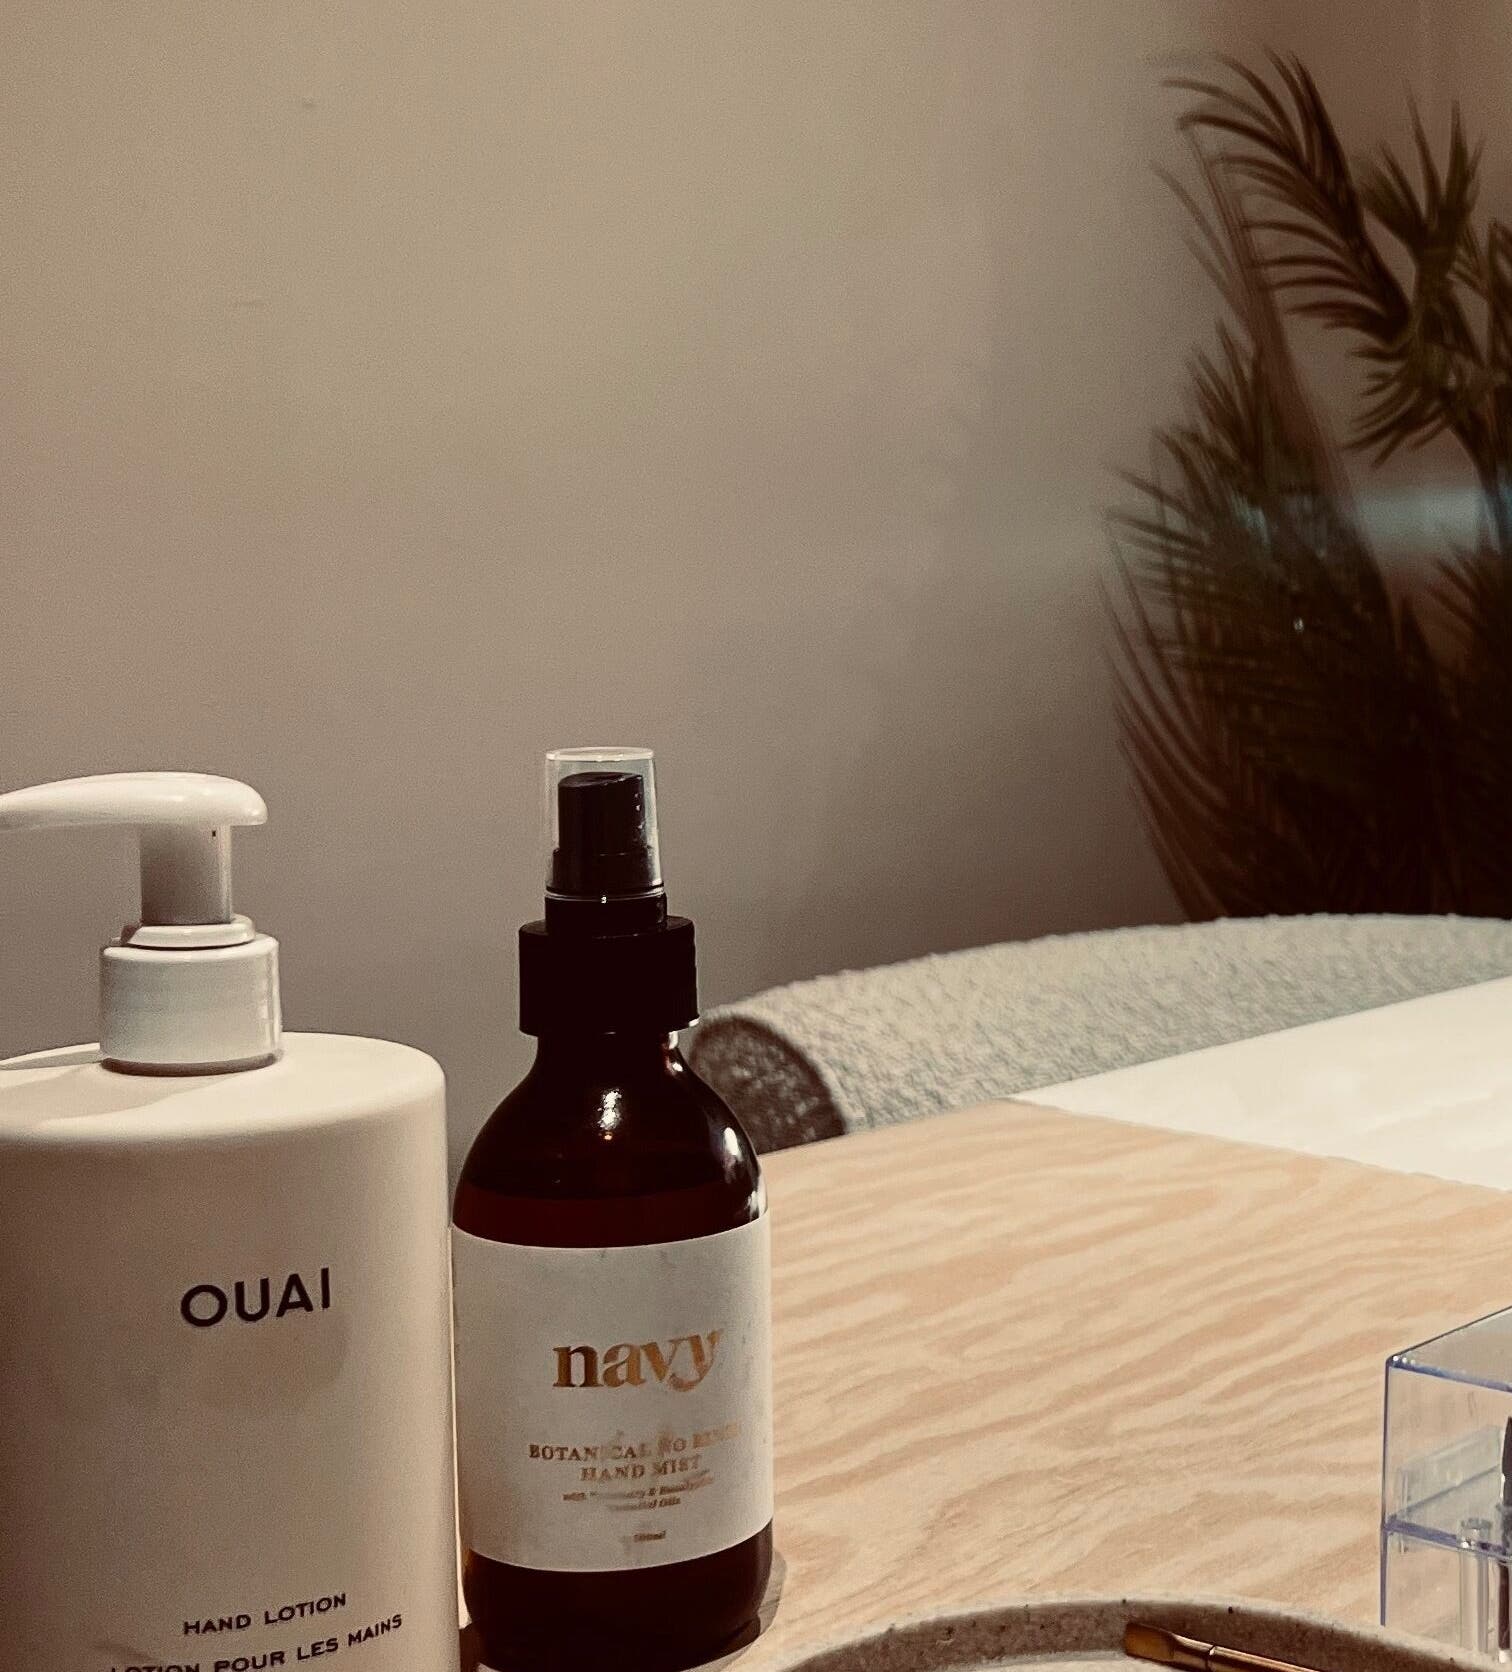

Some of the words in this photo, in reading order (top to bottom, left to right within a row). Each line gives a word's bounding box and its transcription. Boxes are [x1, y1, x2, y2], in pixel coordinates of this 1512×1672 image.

[180, 1267, 331, 1327] OUAI
[552, 1328, 723, 1392] navy
[529, 1443, 652, 1461] BOTANCAL
[580, 1464, 645, 1481] HAND
[183, 1614, 251, 1635] HAND
[264, 1593, 347, 1625] LOTION
[214, 1651, 285, 1672] POUR
[297, 1638, 339, 1661] LES
[348, 1614, 402, 1648] MAINS
